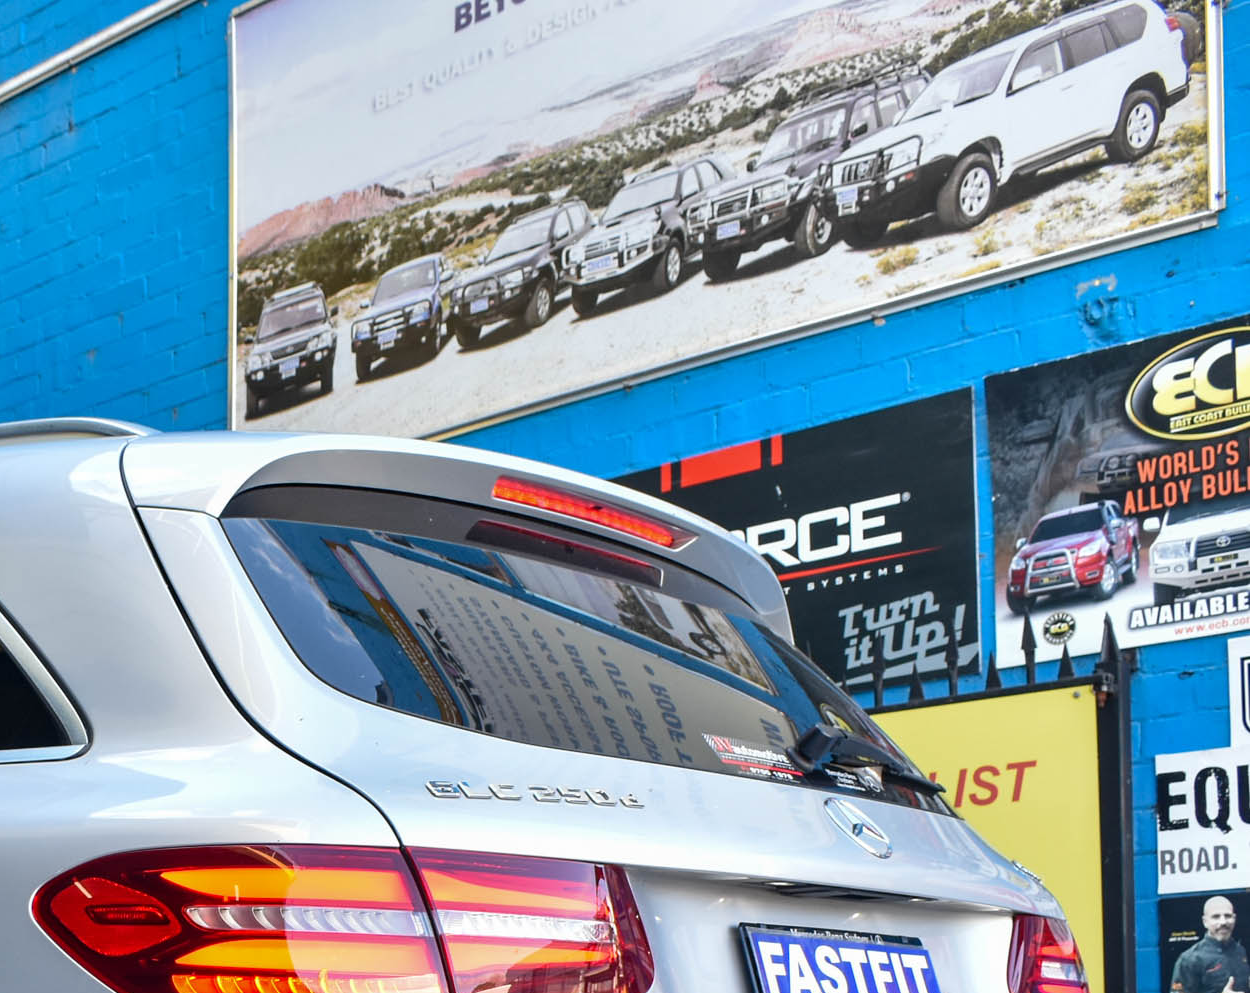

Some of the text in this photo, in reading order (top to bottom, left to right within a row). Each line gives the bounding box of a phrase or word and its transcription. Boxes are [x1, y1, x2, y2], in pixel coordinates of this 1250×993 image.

[454, 0, 527, 33] BEY
[1170, 417, 1194, 430] EAST
[1193, 410, 1224, 424] COAST
[1137, 440, 1240, 484] WORLD'S
[1124, 466, 1250, 516] ALLOY BUL
[728, 493, 902, 567] RCE
[807, 564, 904, 592] SYSTEMS
[838, 591, 940, 639] Turn
[1130, 591, 1250, 629] AVAILABLE
[1174, 616, 1250, 636] www.ecb.co
[844, 634, 874, 670] it
[425, 781, 523, 801] GLC
[1160, 845, 1238, 876] ROAD.
